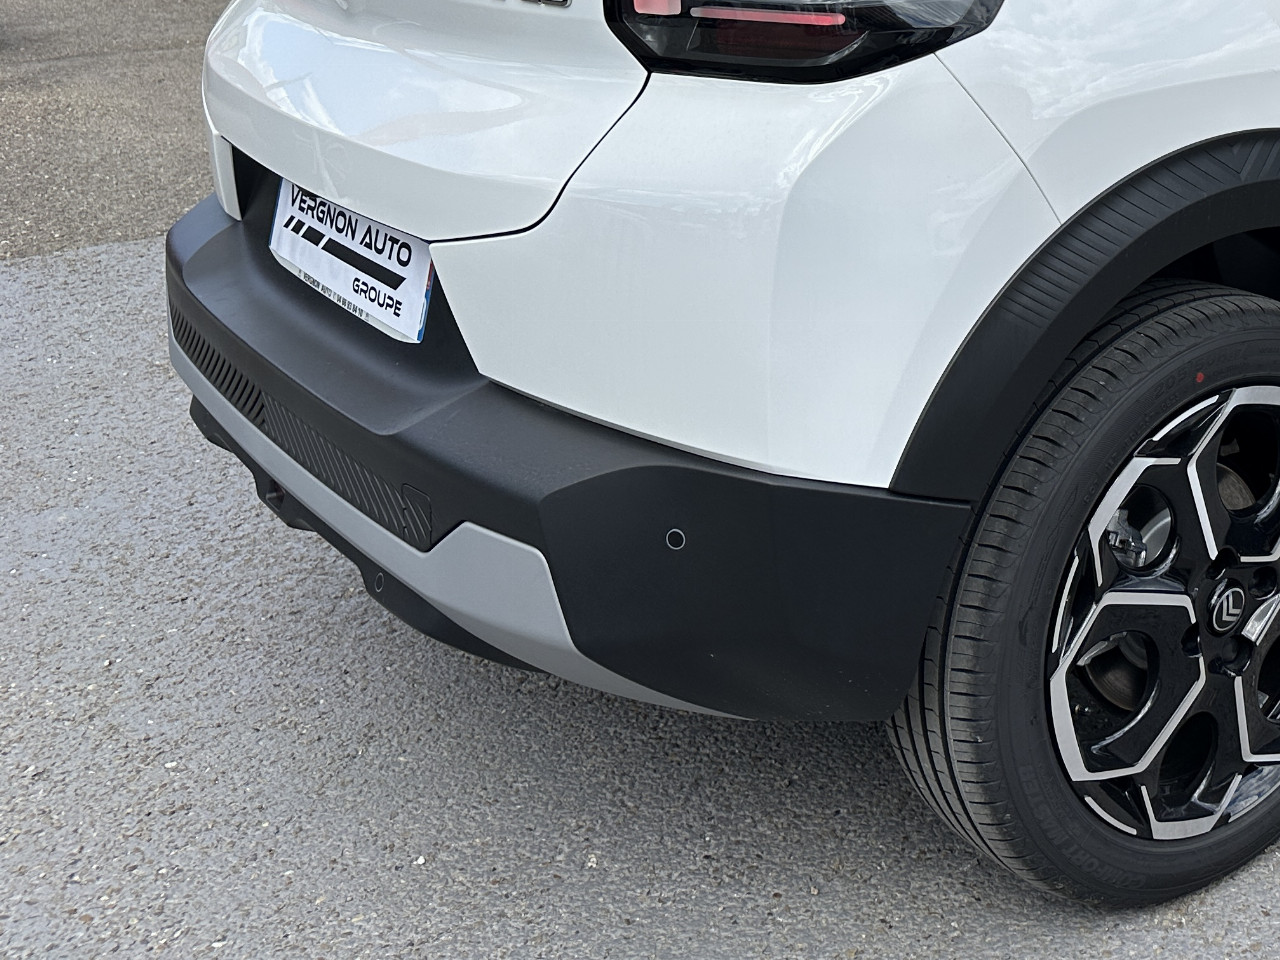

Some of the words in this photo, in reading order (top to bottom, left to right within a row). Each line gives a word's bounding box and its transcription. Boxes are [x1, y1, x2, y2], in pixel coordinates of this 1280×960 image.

[291, 184, 359, 241] VERGNON
[359, 224, 412, 268] AUTO
[352, 277, 403, 318] GROUPE
